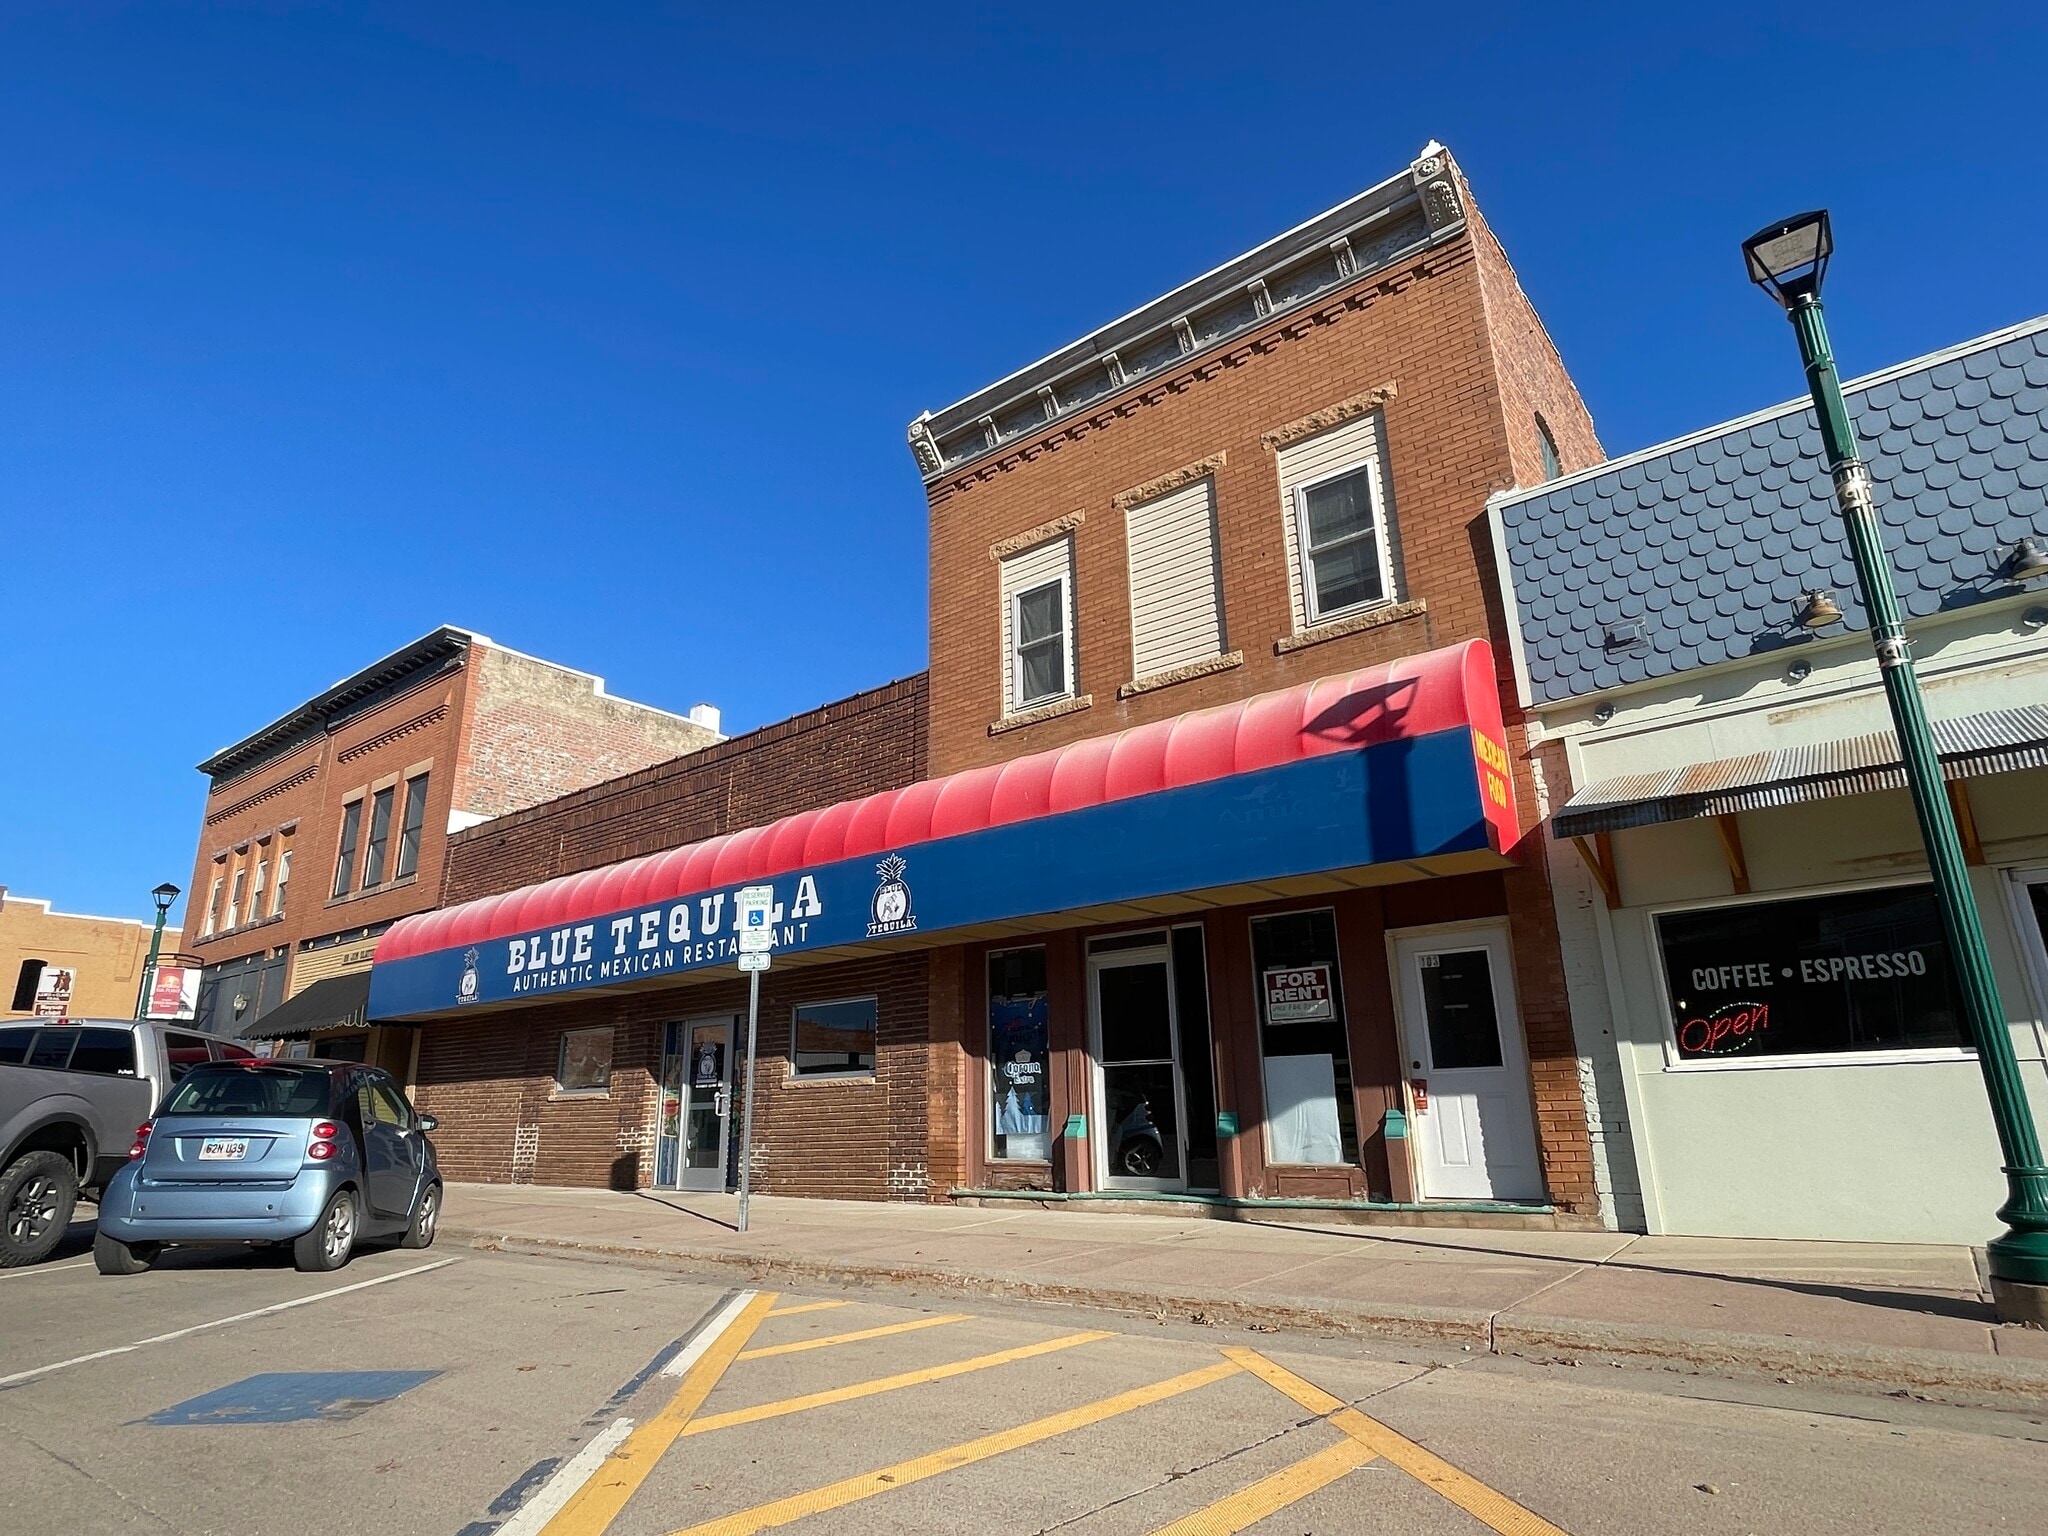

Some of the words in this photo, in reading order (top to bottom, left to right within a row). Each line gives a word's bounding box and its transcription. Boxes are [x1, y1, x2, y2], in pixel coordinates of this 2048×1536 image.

[1486, 770, 1507, 809] FOOD
[871, 920, 912, 934] TEQUILA
[507, 924, 594, 974] BLUE
[513, 964, 593, 992] AUTHENTIC
[600, 949, 676, 979] MEXICAN
[684, 922, 808, 964] RESTAANT
[1421, 956, 1438, 967] 103
[1692, 963, 1774, 991] COFFEE
[1800, 950, 1927, 983] ESPRESSO
[1275, 972, 1317, 988] FOR
[1270, 985, 1325, 1002] RENT
[1680, 1003, 1769, 1052] Open
[1003, 1061, 1042, 1077] Corona
[1014, 1075, 1035, 1084] Extra
[206, 1144, 224, 1153] 62N
[226, 1143, 244, 1153] U39
